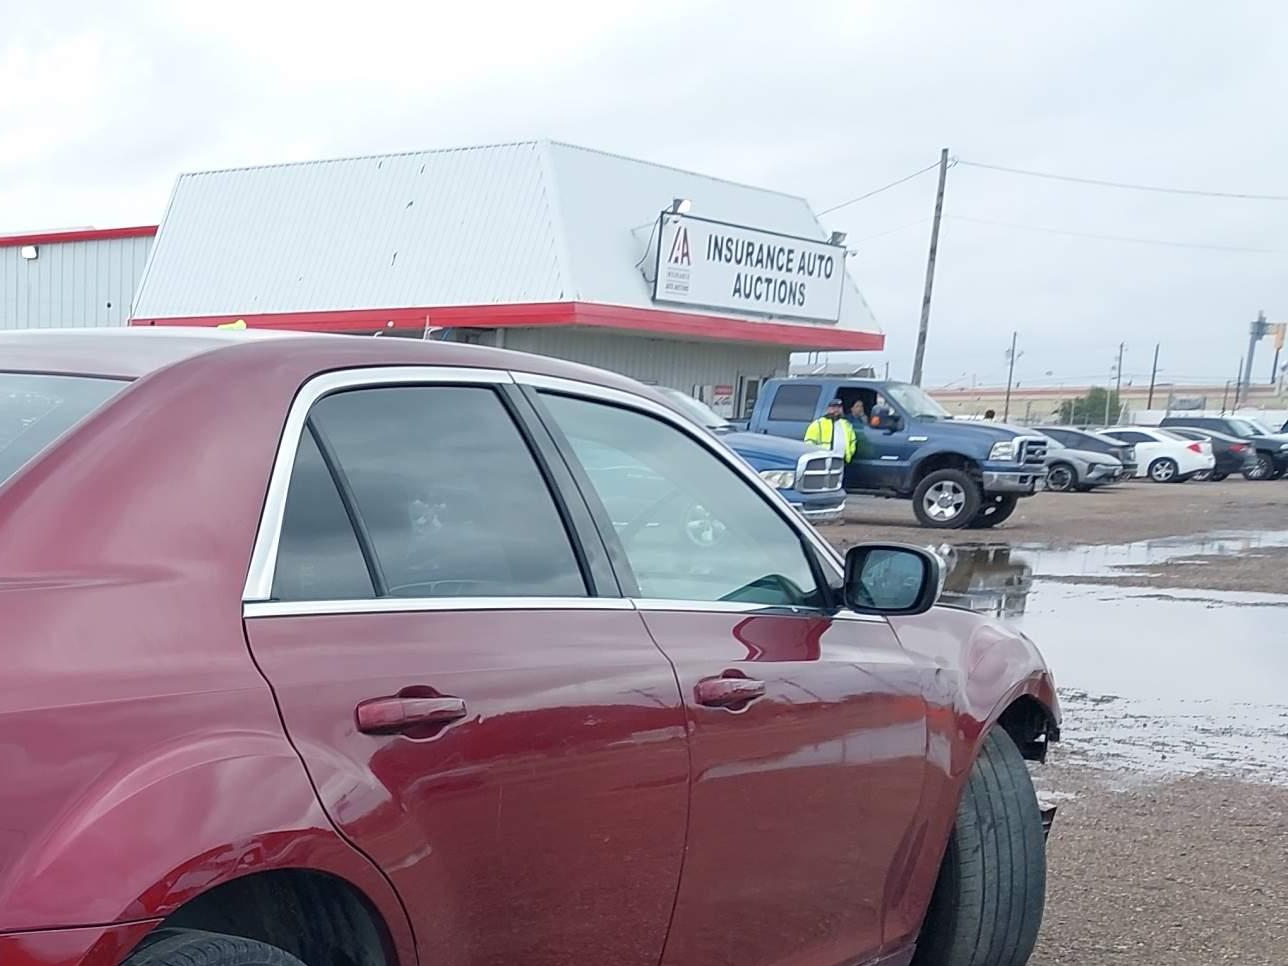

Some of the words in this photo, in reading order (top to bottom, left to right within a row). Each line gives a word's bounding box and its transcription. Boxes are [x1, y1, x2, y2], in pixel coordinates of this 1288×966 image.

[706, 233, 795, 273] INSURANCE
[797, 251, 834, 279] AUTO
[732, 273, 807, 307] AUCTIONS
